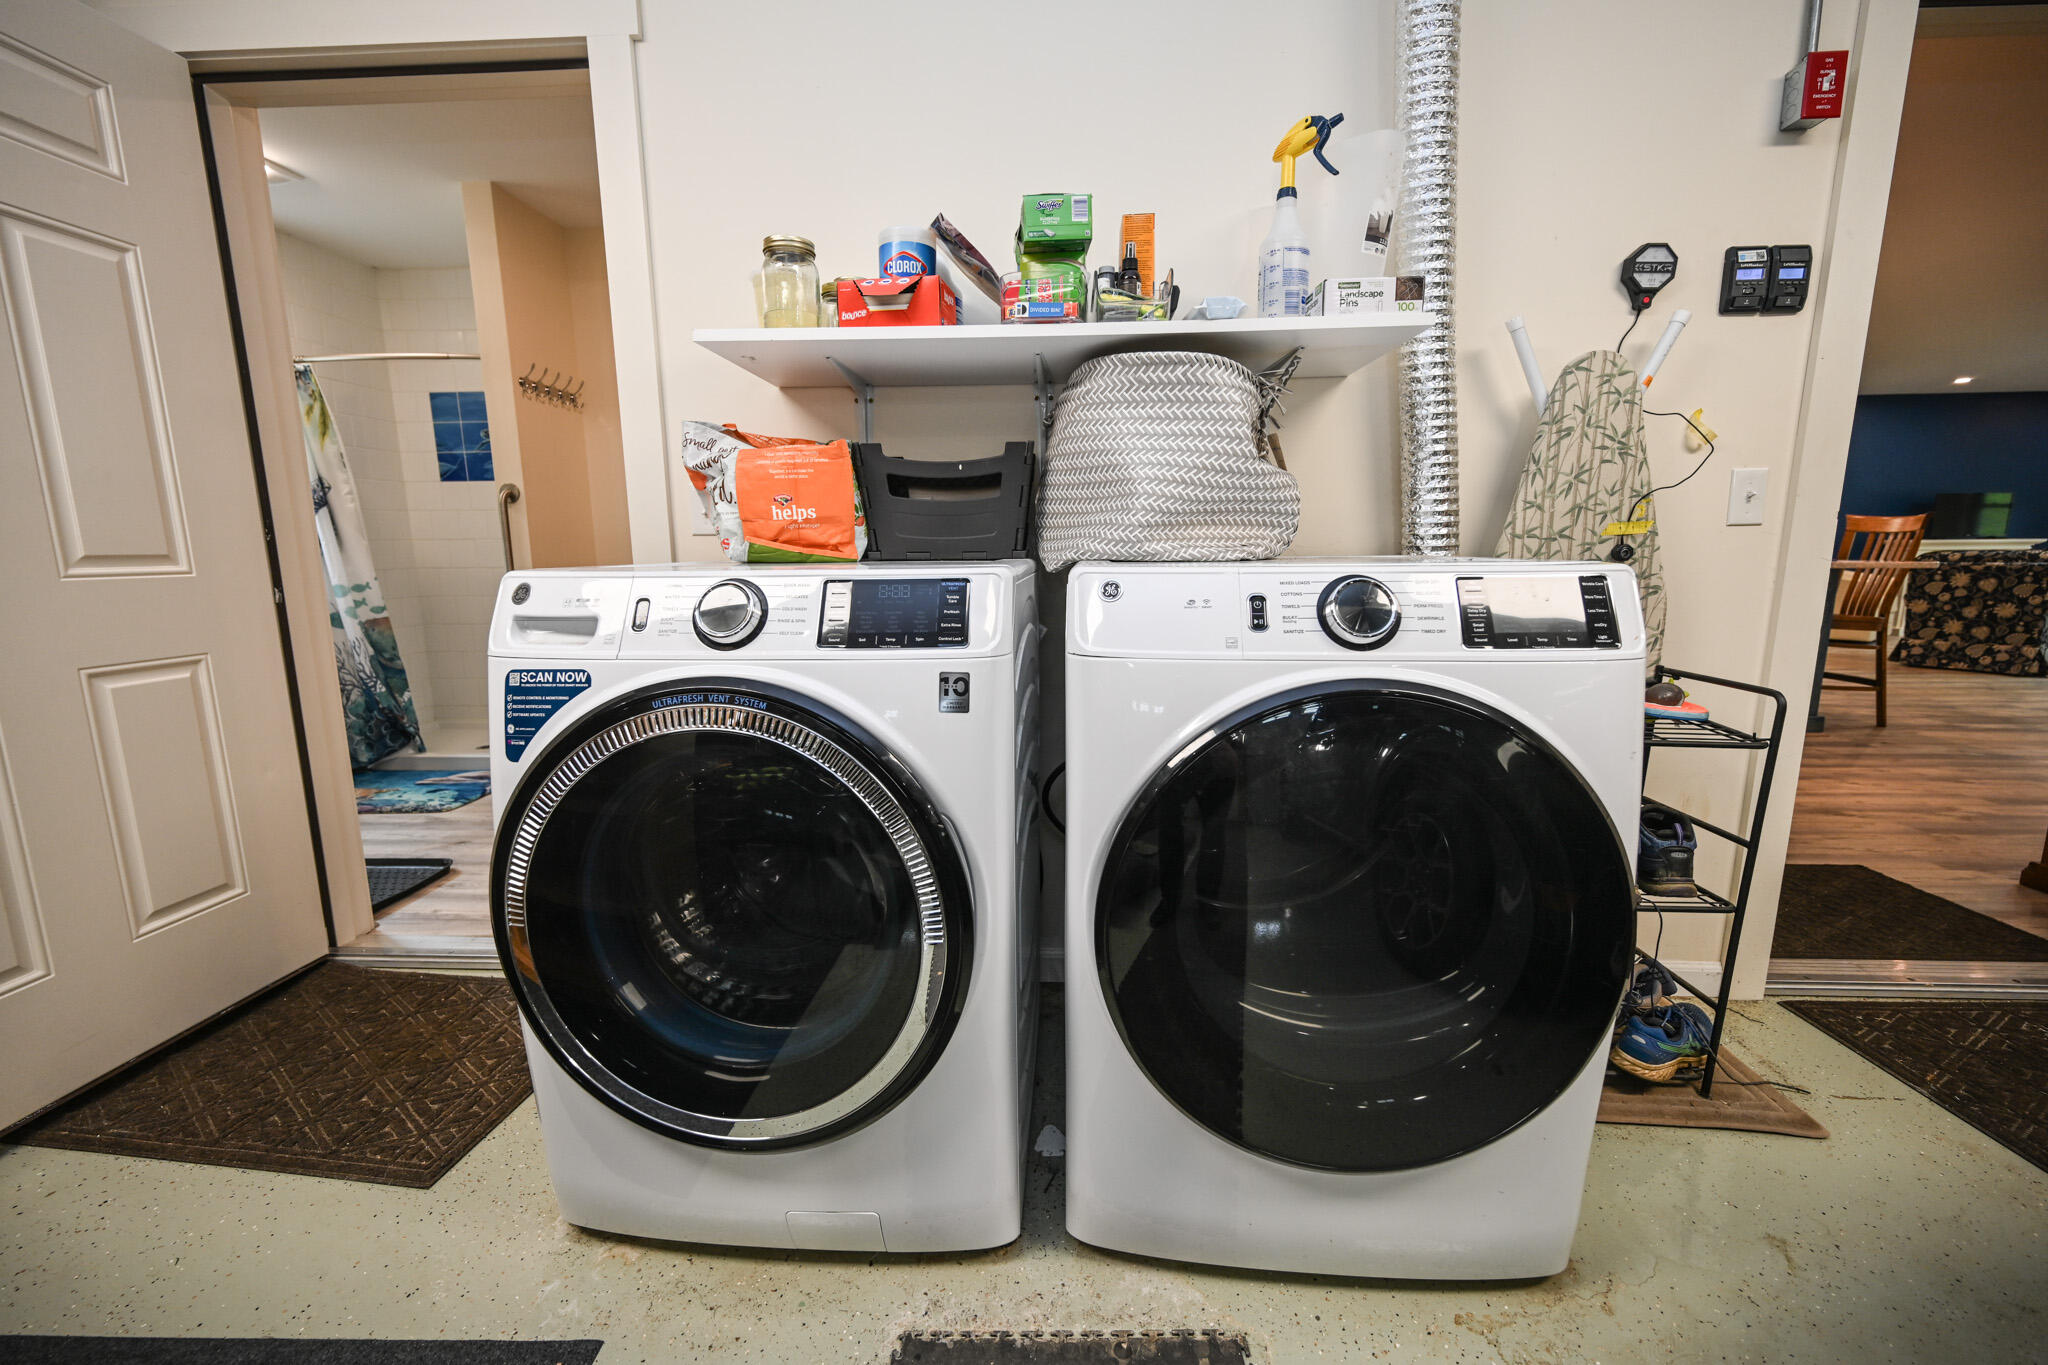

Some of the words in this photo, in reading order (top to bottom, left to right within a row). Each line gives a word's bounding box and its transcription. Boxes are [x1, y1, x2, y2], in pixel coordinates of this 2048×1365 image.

[1035, 199, 1063, 211] Swiffer
[887, 260, 922, 274] CLOROX
[1340, 290, 1384, 299] Landscape
[1340, 298, 1359, 308] Pins
[1397, 301, 1415, 312] 100
[841, 309, 867, 320] bounce
[682, 432, 717, 452] Small
[771, 504, 817, 522] helps
[521, 672, 553, 683] SCAN
[556, 672, 588, 683] NOW
[940, 676, 969, 697] 10
[651, 694, 704, 709] ULTRAFRESH
[708, 694, 731, 704] VENT
[734, 696, 768, 710] SYSTEM
